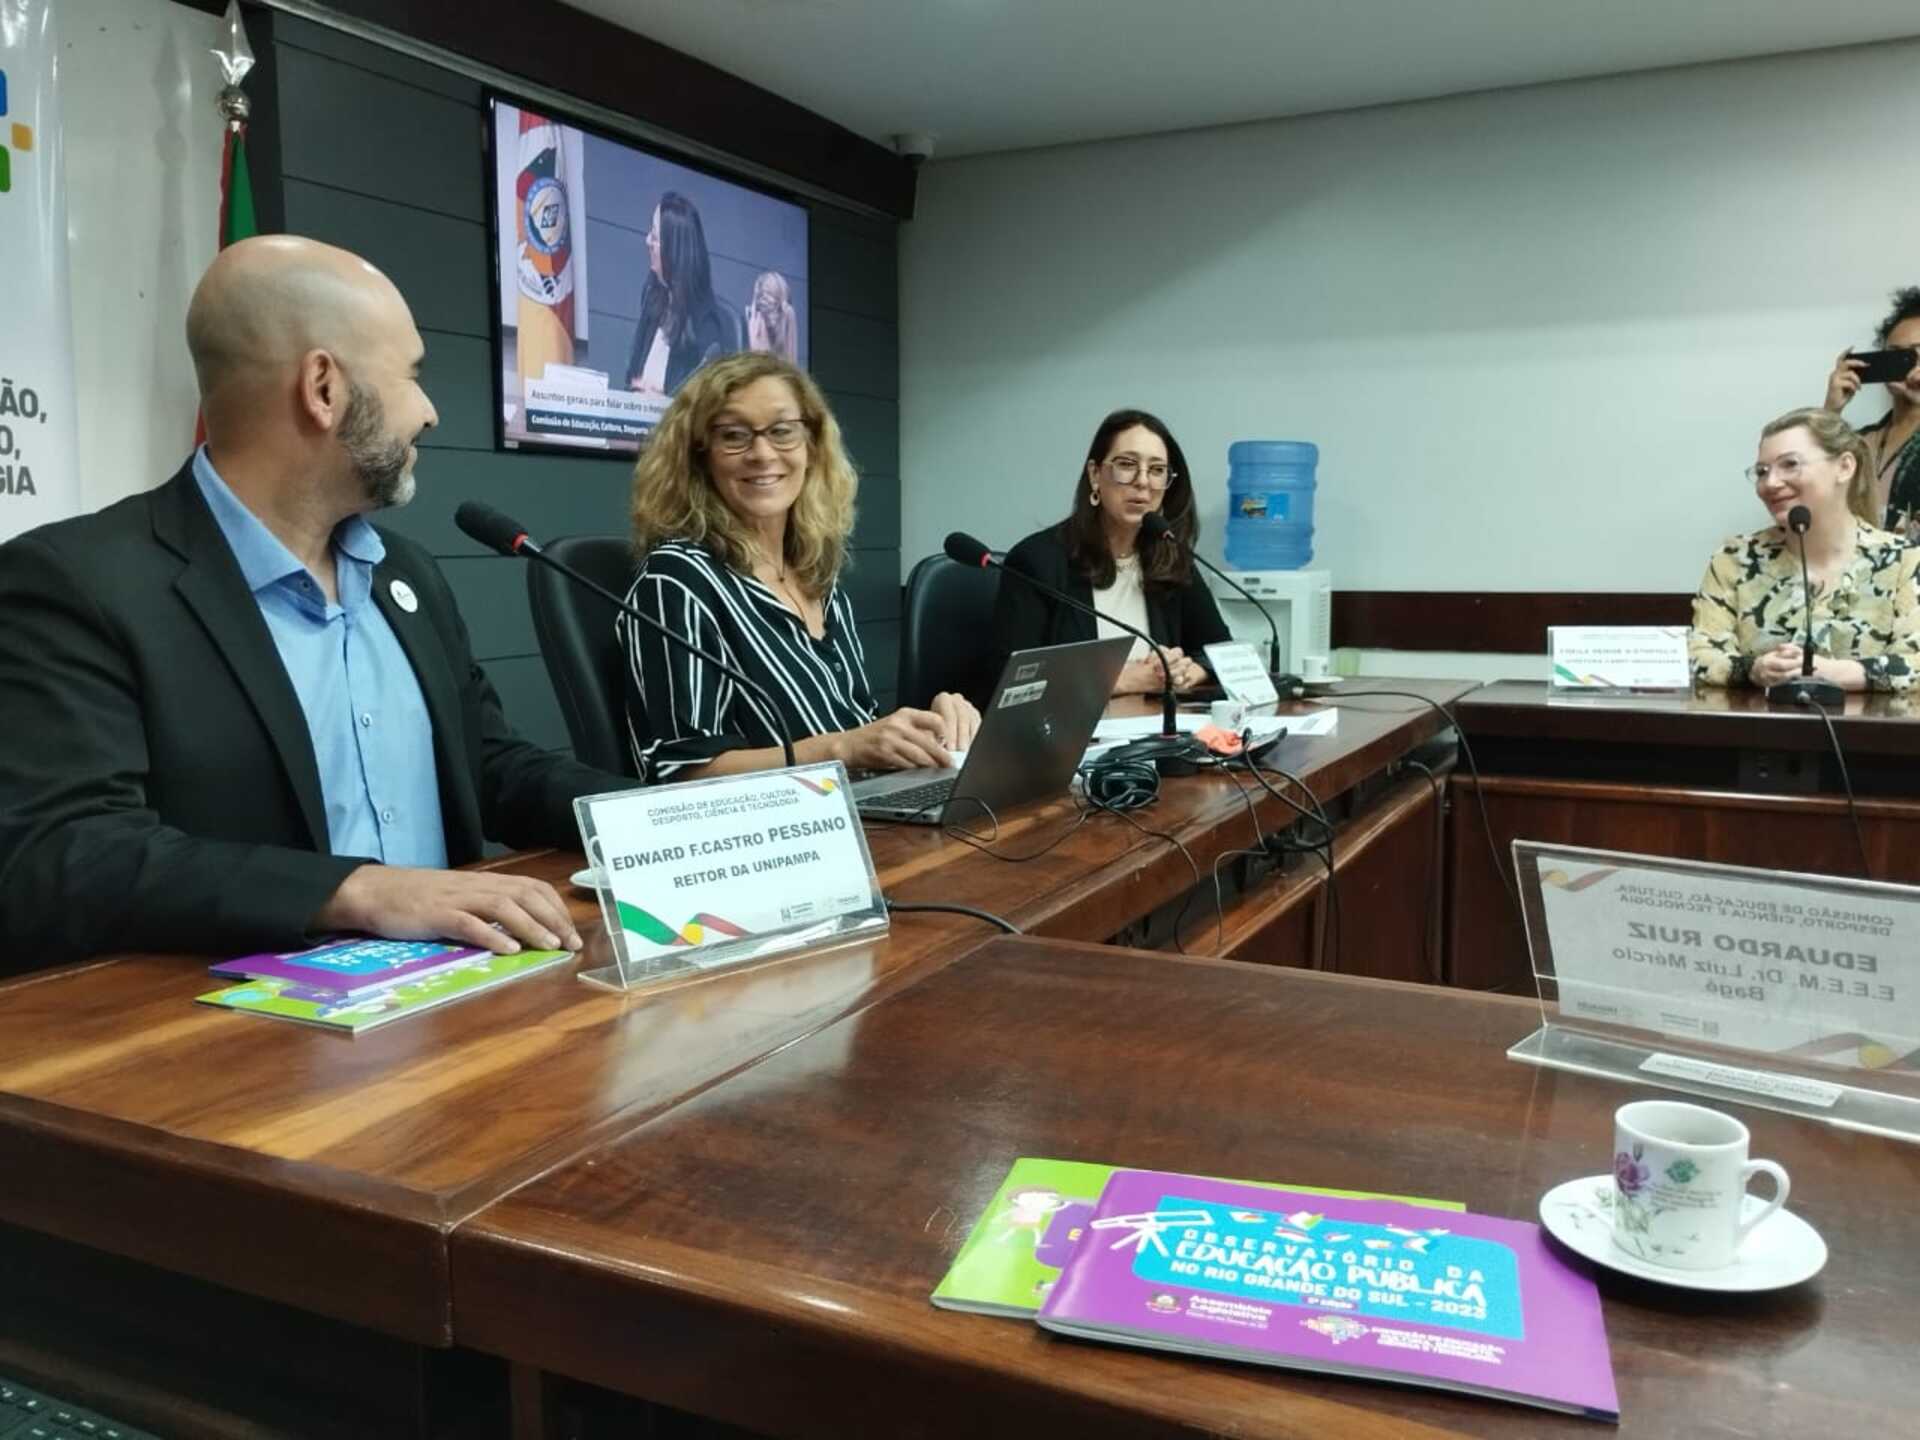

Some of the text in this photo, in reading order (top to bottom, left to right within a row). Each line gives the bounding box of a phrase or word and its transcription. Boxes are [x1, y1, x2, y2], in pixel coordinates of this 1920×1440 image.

[532, 415, 561, 426] Comissão
[562, 417, 570, 426] de
[567, 393, 588, 407] gerais
[589, 397, 605, 409] para
[607, 397, 622, 409] falar
[623, 400, 642, 412] sobre
[648, 802, 695, 817] COMISSÃO
[697, 799, 708, 810] DE
[652, 797, 800, 826] DESPORTO, CIÊNCIA E TECNOLOGIA
[612, 816, 847, 871] EDWARD F.CASTRO PESSANO
[673, 850, 821, 889] REITOR DA UNIPAMPA
[1176, 1239, 1337, 1282] EDUCAÇÃO
[1183, 1228, 1485, 1284] OBSERVATÓRIO DA
[1170, 1260, 1200, 1275] NO
[1203, 1265, 1239, 1282] RIO
[1243, 1273, 1328, 1297] GRANDE
[1333, 1286, 1362, 1301] DO
[1367, 1290, 1409, 1307] SUL
